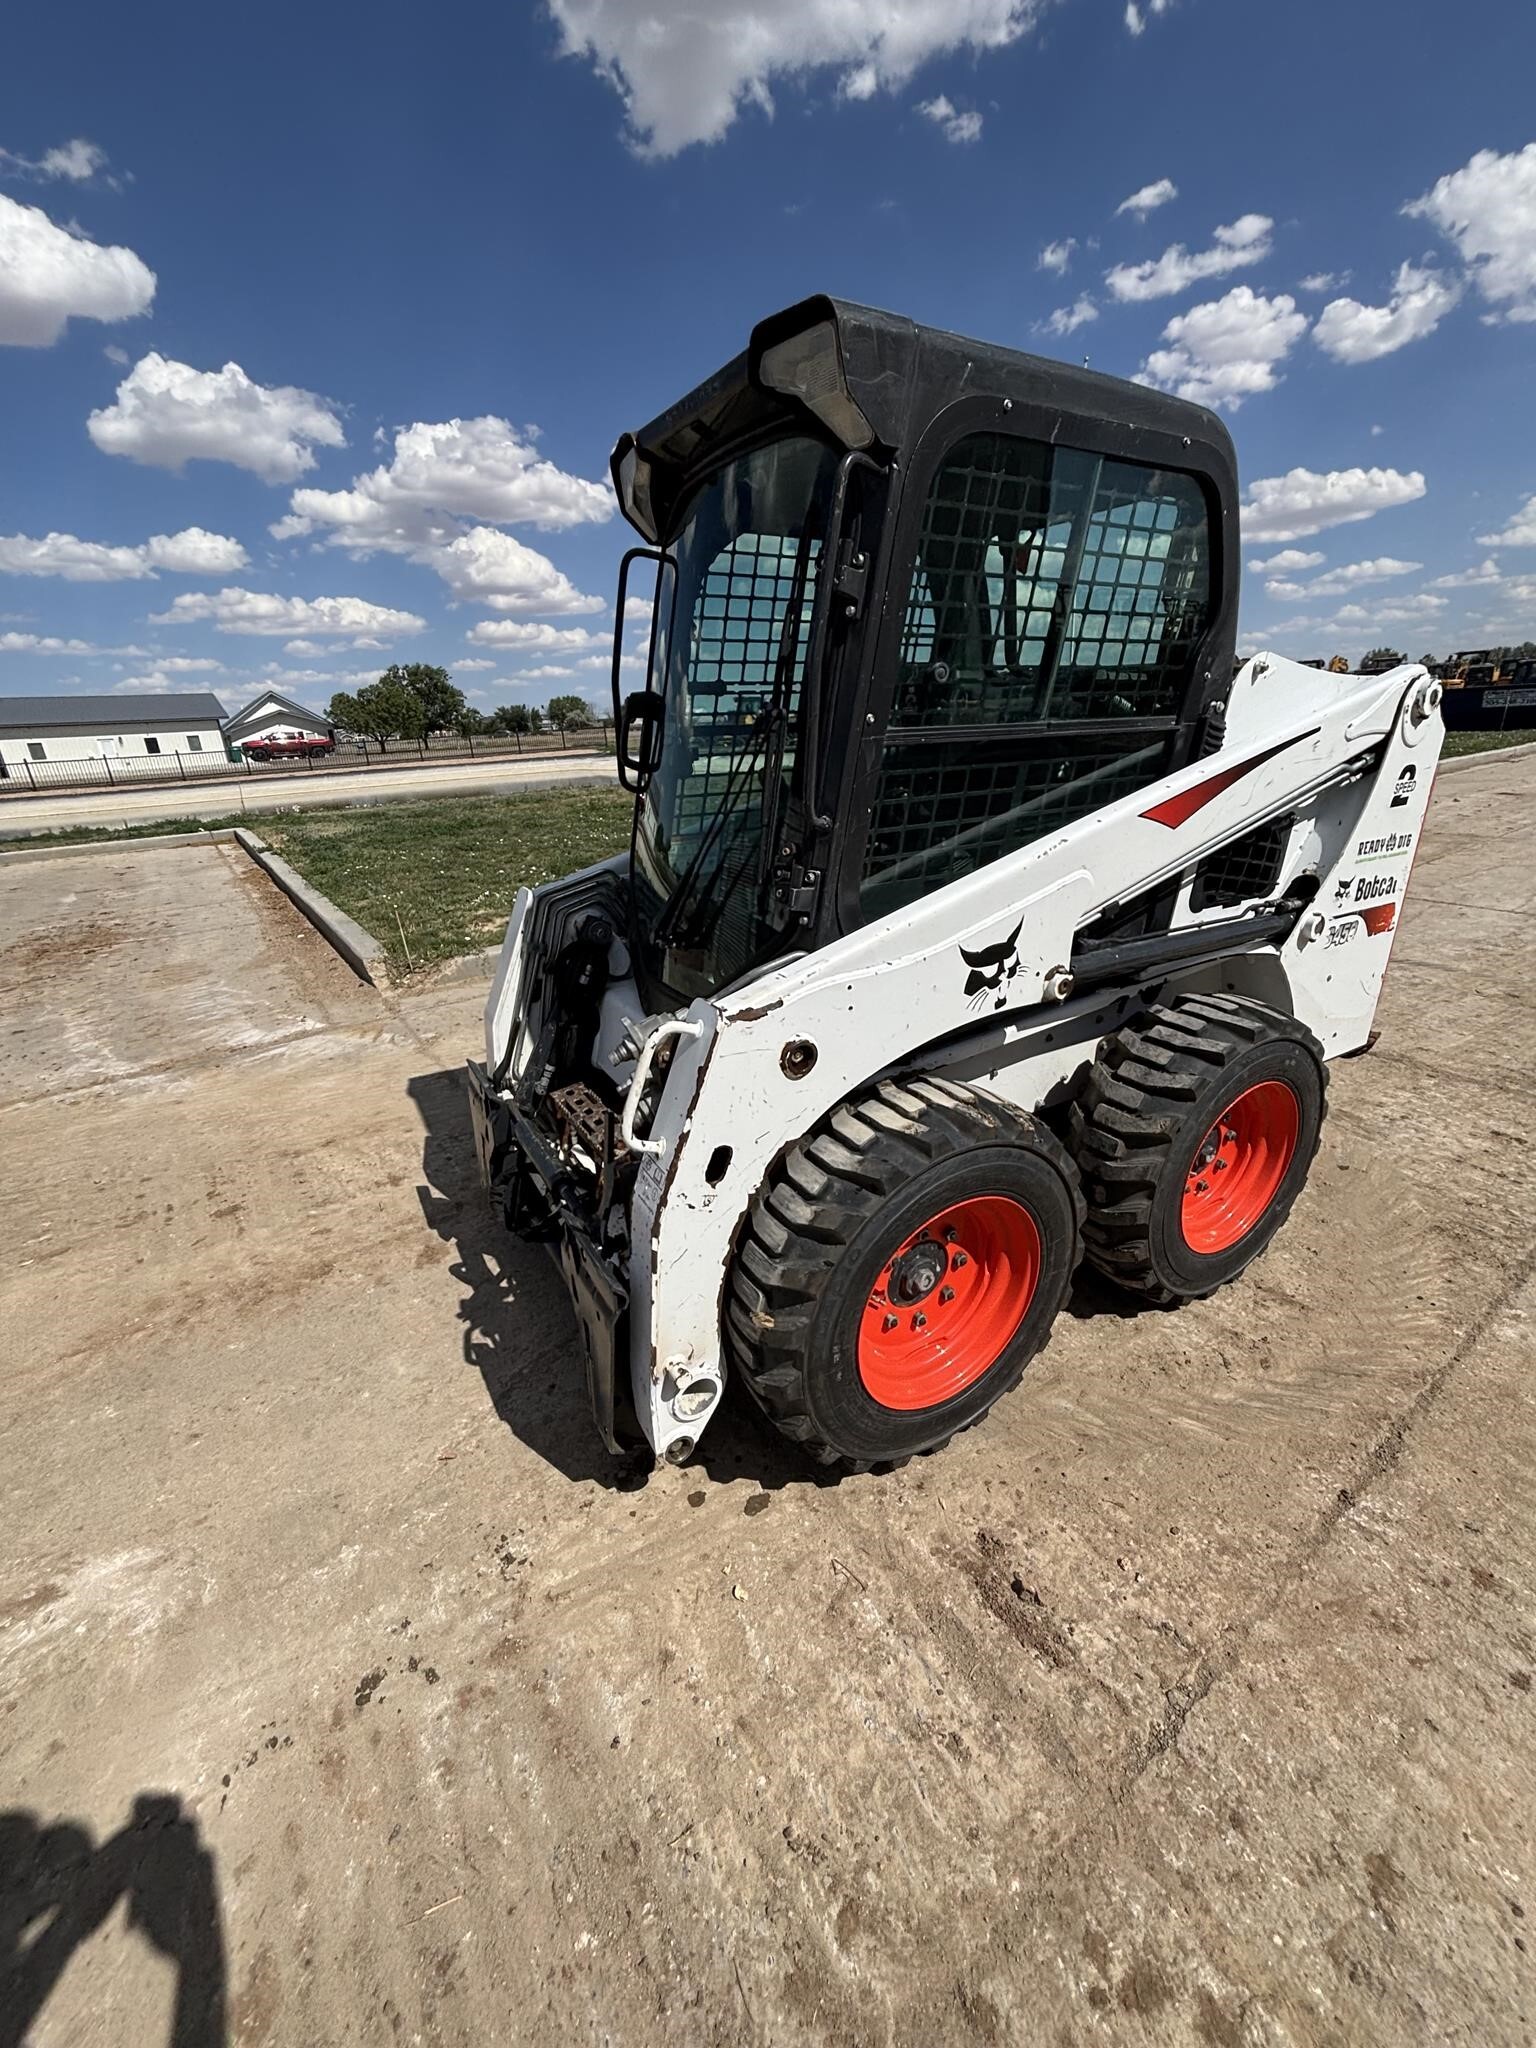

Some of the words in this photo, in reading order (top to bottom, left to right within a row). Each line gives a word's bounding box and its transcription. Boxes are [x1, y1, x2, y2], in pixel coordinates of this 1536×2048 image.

[1393, 780, 1417, 795] SPEED
[1357, 838, 1387, 857] READY
[1397, 834, 1413, 849] DIG
